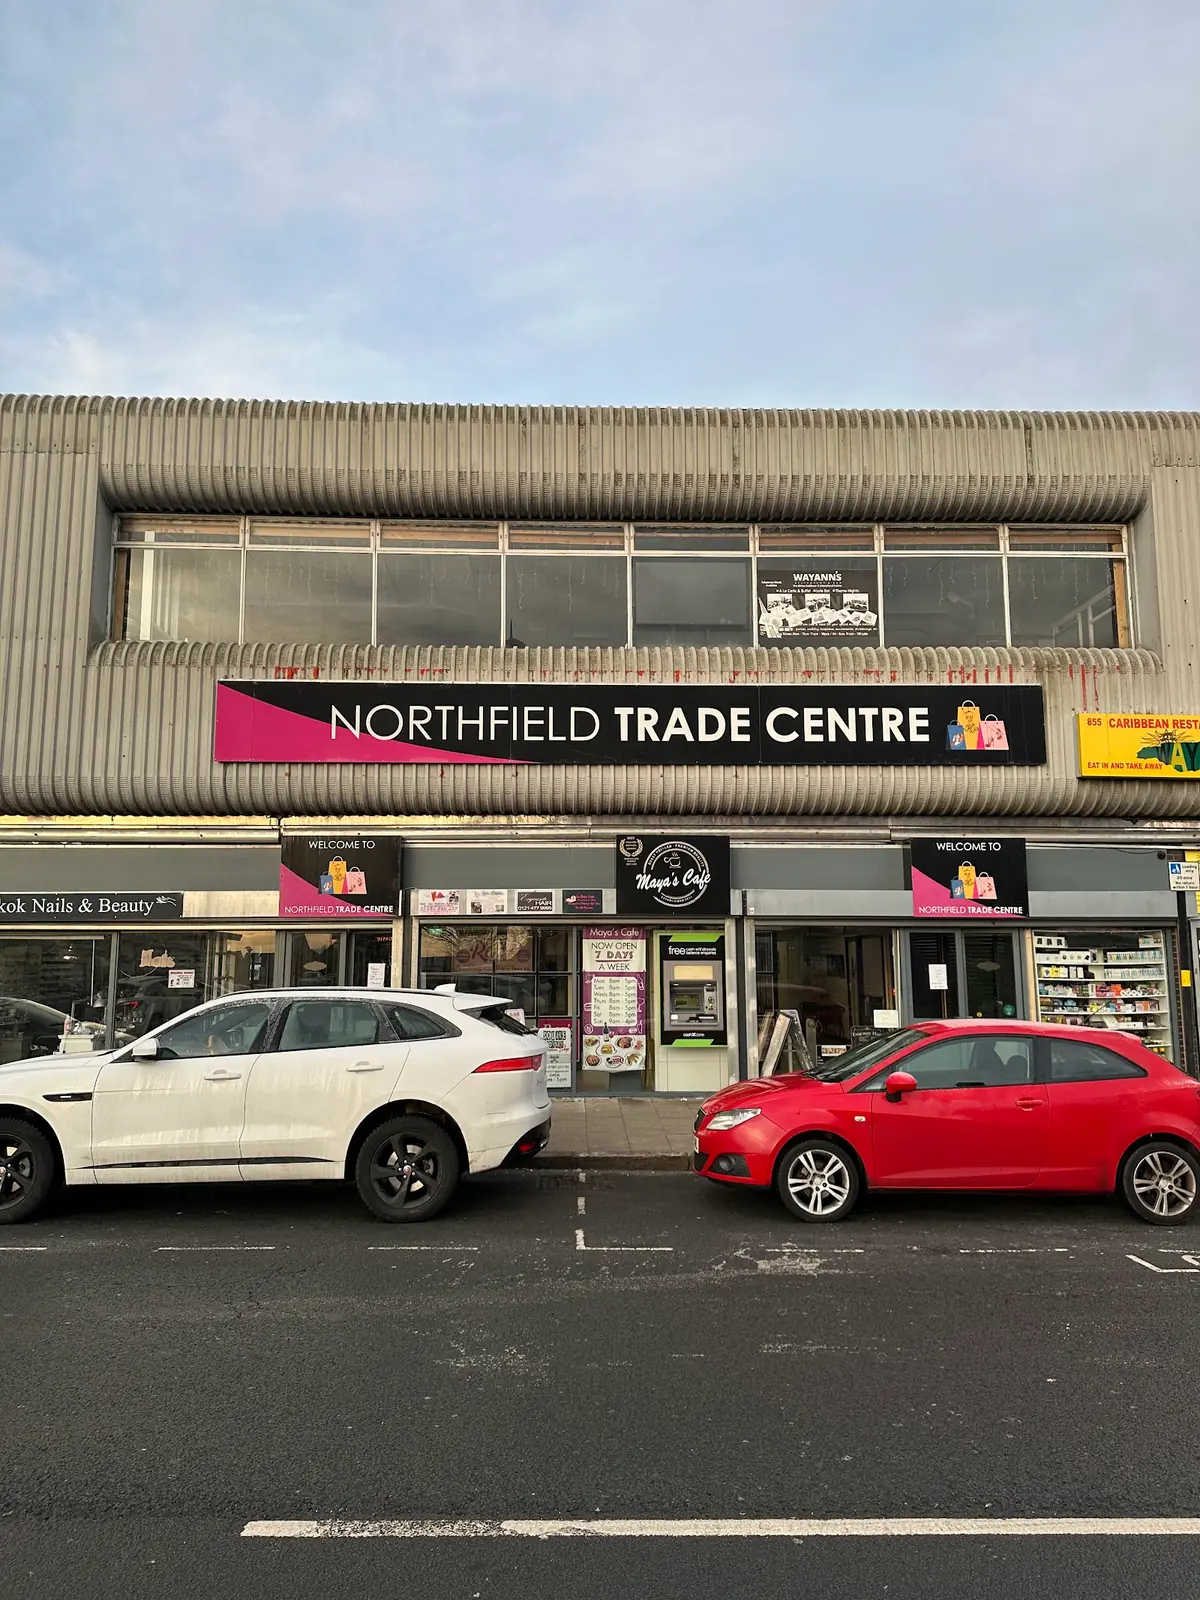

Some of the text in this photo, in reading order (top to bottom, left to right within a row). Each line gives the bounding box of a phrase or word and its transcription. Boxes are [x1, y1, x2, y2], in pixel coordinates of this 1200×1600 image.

[793, 571, 842, 581] WAYANN'S
[331, 704, 930, 742] NORTHFIELD TRADE CENTRE
[1087, 717, 1200, 731] 855 CARIBBEAN REST
[309, 840, 376, 850] WELCOME TO
[936, 842, 1001, 851] WELCOME TO
[636, 868, 711, 893] Maya's Cafe
[32, 898, 74, 913] Nails
[78, 898, 94, 913] &
[98, 898, 154, 916] Beauty
[284, 905, 394, 914] NORTHFIELD TRADE CENTRE
[919, 906, 1023, 914] NORTHFIELD TRADE CENTRE
[590, 927, 640, 938] Maya's Cafe
[592, 942, 637, 950] NOW OPEN
[668, 946, 685, 955] free
[595, 951, 633, 959] 7 DAYS
